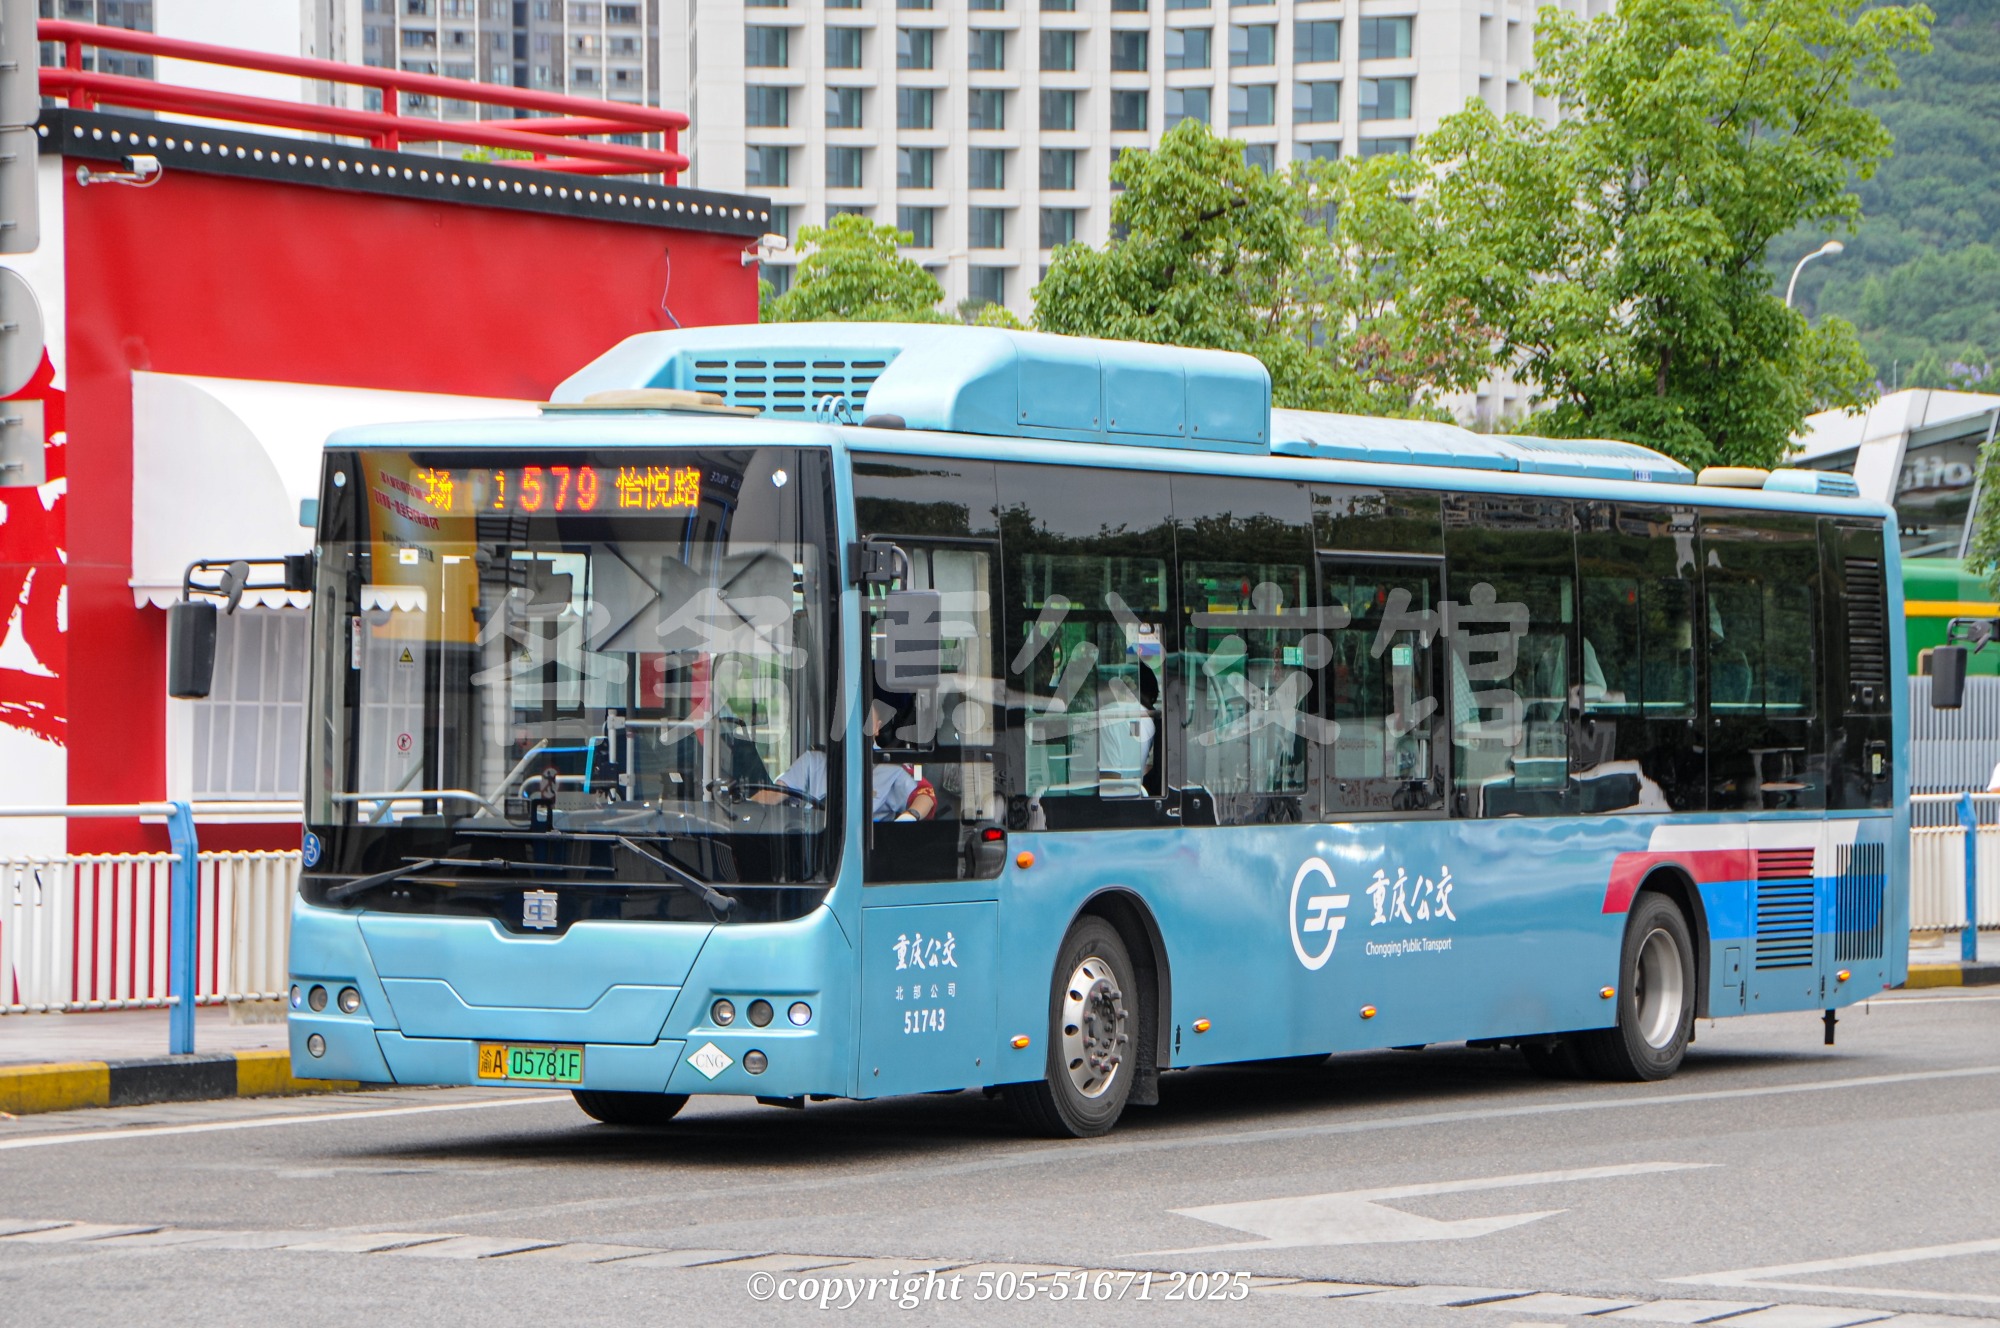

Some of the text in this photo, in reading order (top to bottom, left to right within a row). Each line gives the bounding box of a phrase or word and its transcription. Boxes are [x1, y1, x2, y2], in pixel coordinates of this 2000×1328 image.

[520, 465, 598, 512] 579
[615, 465, 701, 510] 怡悦路
[1365, 865, 1457, 927] 重庆公交
[892, 931, 958, 971] 重庆公交
[1365, 937, 1452, 958] Chongqing Public Transport
[895, 982, 956, 1001] 北部公司
[904, 1008, 945, 1034] 51743
[695, 1053, 724, 1069] CNG
